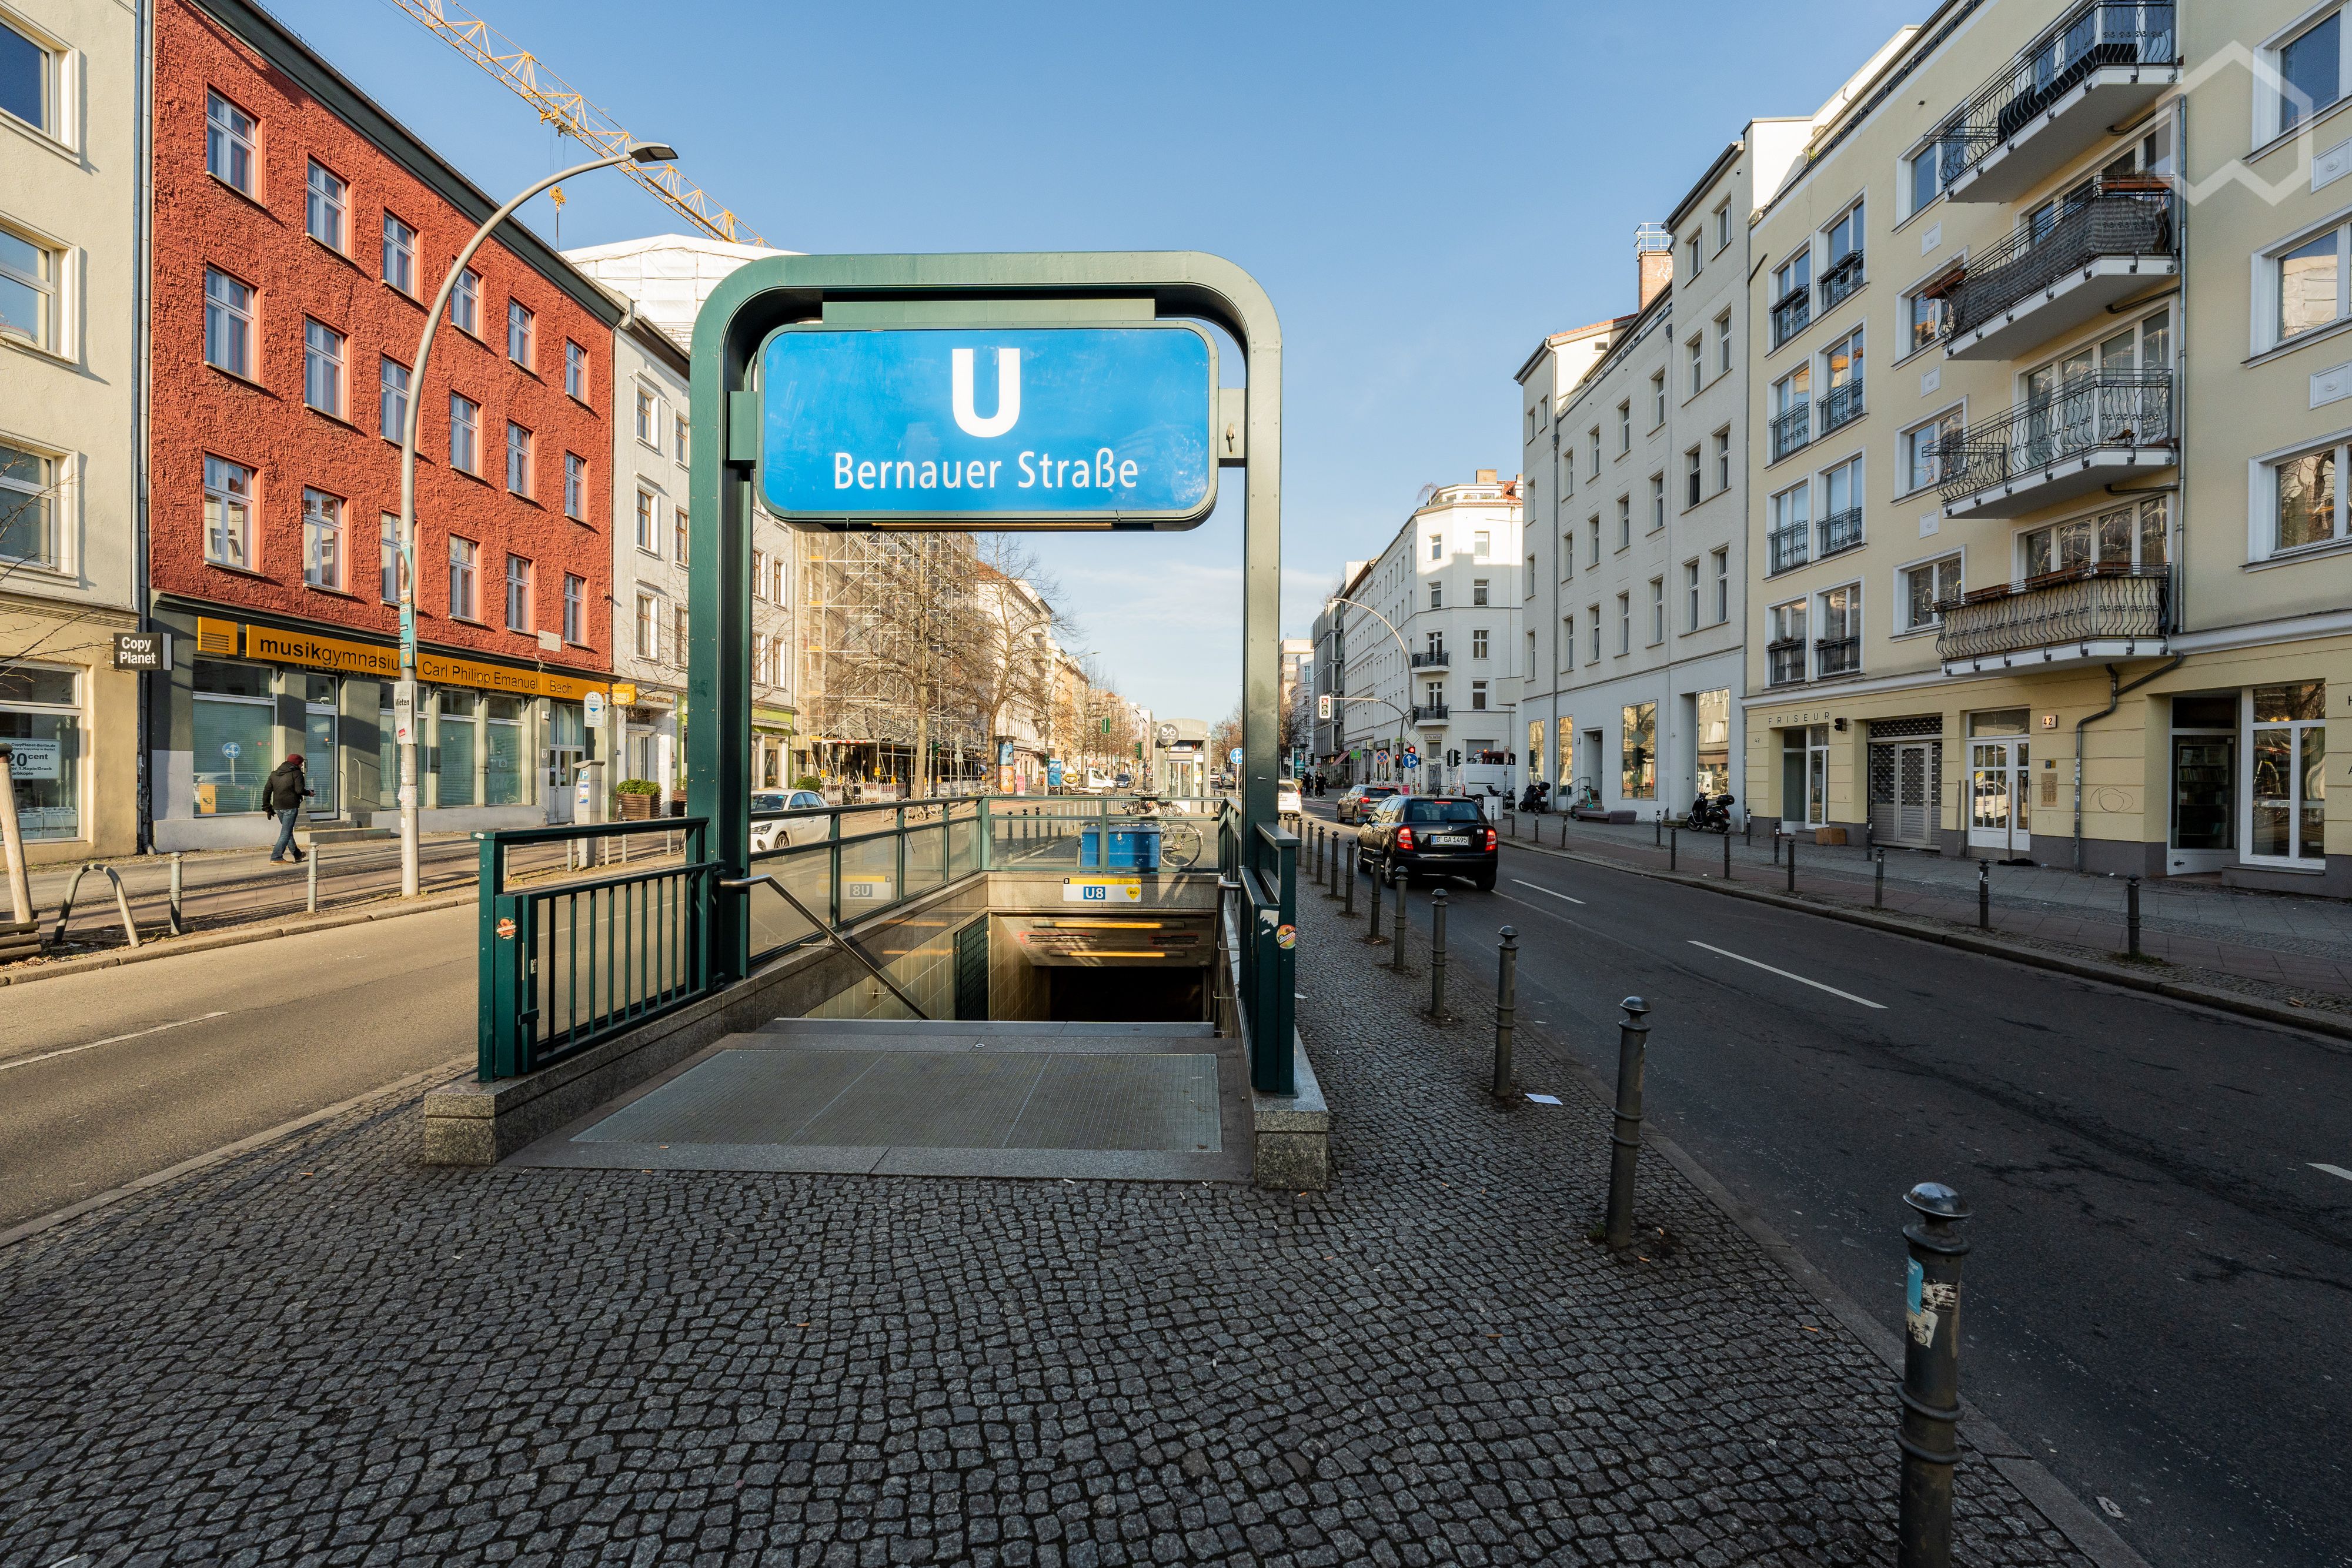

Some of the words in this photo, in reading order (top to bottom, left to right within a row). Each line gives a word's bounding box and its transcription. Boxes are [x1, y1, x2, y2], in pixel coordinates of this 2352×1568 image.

[952, 348, 1020, 437] U
[834, 452, 1001, 489] Bernauer
[1018, 447, 1138, 489] Straße
[122, 637, 152, 652] Copy
[120, 651, 156, 664] Planet
[260, 638, 400, 671] musikgymnasiu
[422, 661, 447, 678] Carl
[452, 665, 490, 684] Philipp
[494, 672, 538, 690] Emanuel
[550, 680, 572, 694] Bach
[1768, 712, 1829, 724] FRISEUR
[2043, 717, 2052, 726] 42
[582, 771, 588, 779] P
[1085, 887, 1104, 898] U8
